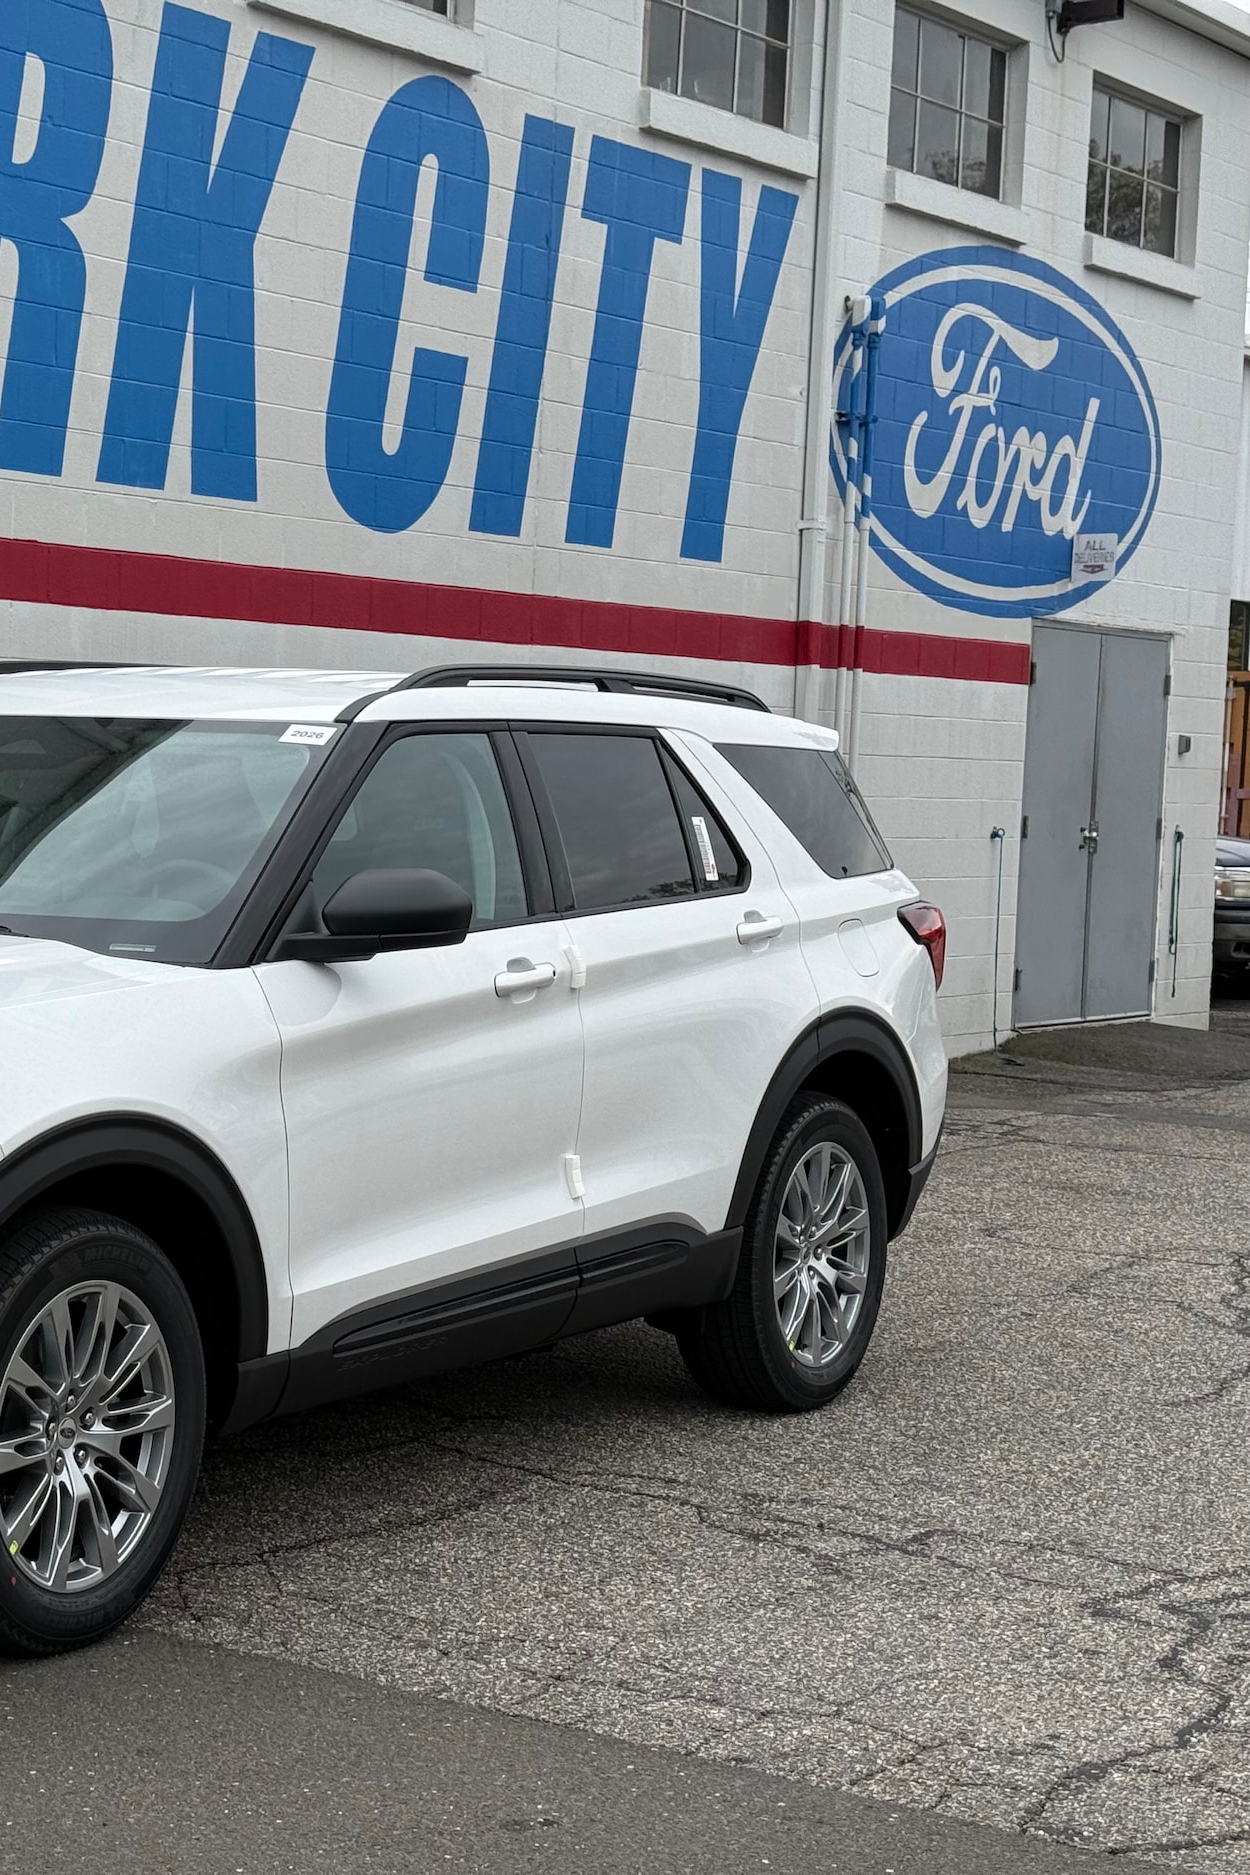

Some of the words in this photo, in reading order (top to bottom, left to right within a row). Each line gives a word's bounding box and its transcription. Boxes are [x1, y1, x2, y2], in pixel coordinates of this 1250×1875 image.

[325, 75, 799, 563] CITY
[904, 302, 1100, 540] Ford
[1084, 540, 1106, 551] ALL
[290, 730, 325, 739] 2026
[84, 1245, 150, 1273] MICHELIN
